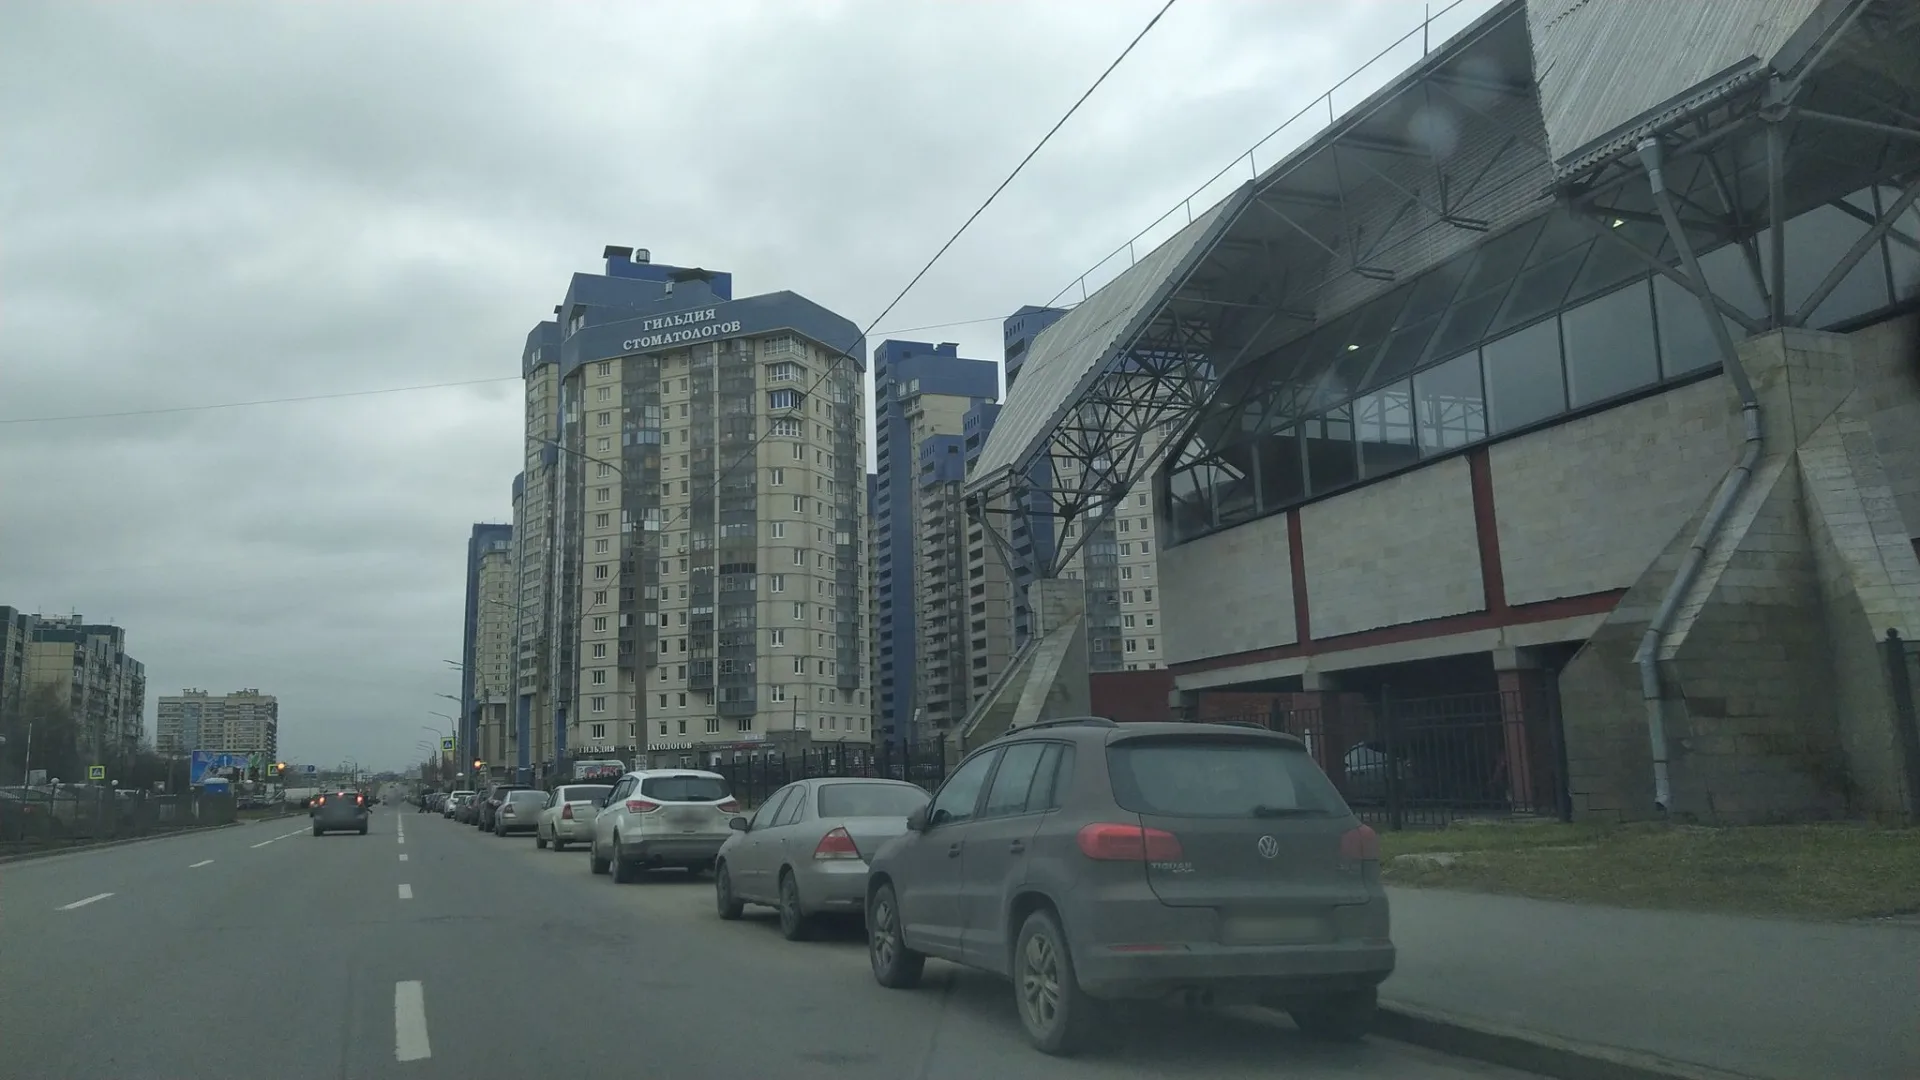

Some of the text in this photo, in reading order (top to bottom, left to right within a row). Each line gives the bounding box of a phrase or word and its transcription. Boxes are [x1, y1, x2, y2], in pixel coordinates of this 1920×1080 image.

[643, 308, 716, 331] ГИЛЬДИЯ
[623, 320, 741, 350] СТОМАТОЛОГОВ
[579, 745, 615, 754] ГИЛЬДИЯ
